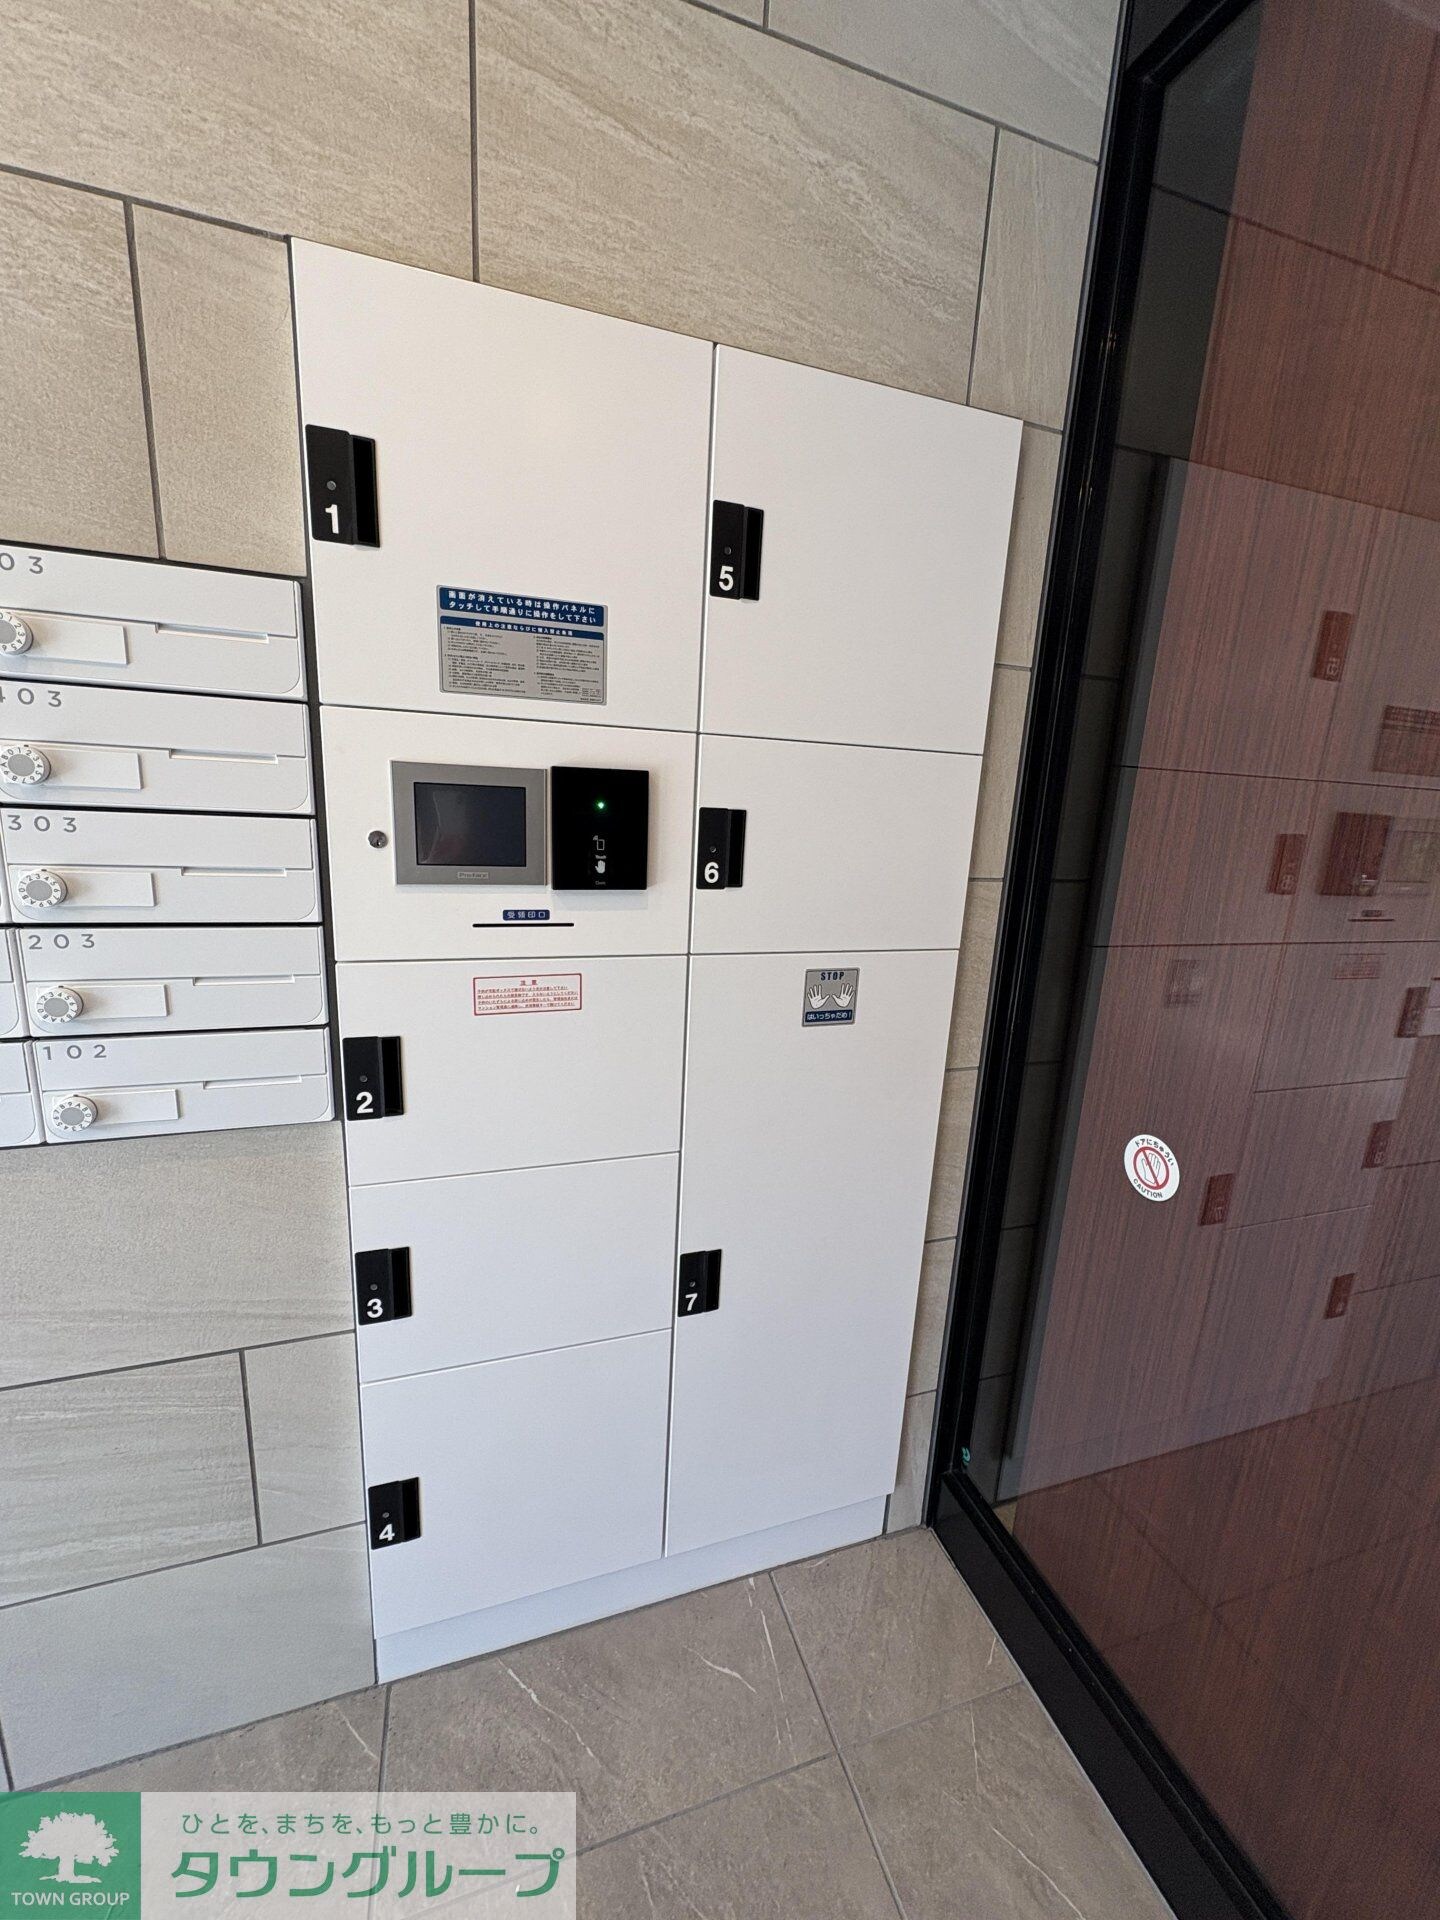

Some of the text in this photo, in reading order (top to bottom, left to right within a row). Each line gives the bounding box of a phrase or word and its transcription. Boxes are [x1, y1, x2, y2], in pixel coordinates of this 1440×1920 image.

[325, 504, 340, 534] 1
[718, 565, 734, 591] 5
[448, 590, 596, 615] 画面が消えている時は操作パネルに
[7, 814, 77, 833] 303
[704, 861, 719, 884] 6
[28, 933, 95, 950] 203
[820, 971, 845, 981] STOP
[43, 1044, 107, 1061] 102
[356, 1091, 374, 1114] 2
[1134, 1138, 1174, 1166] ドアにちゅうい
[1133, 1178, 1163, 1198] CAUTION
[366, 1298, 384, 1319] 3
[685, 1293, 698, 1312] 7
[379, 1523, 395, 1541] 4
